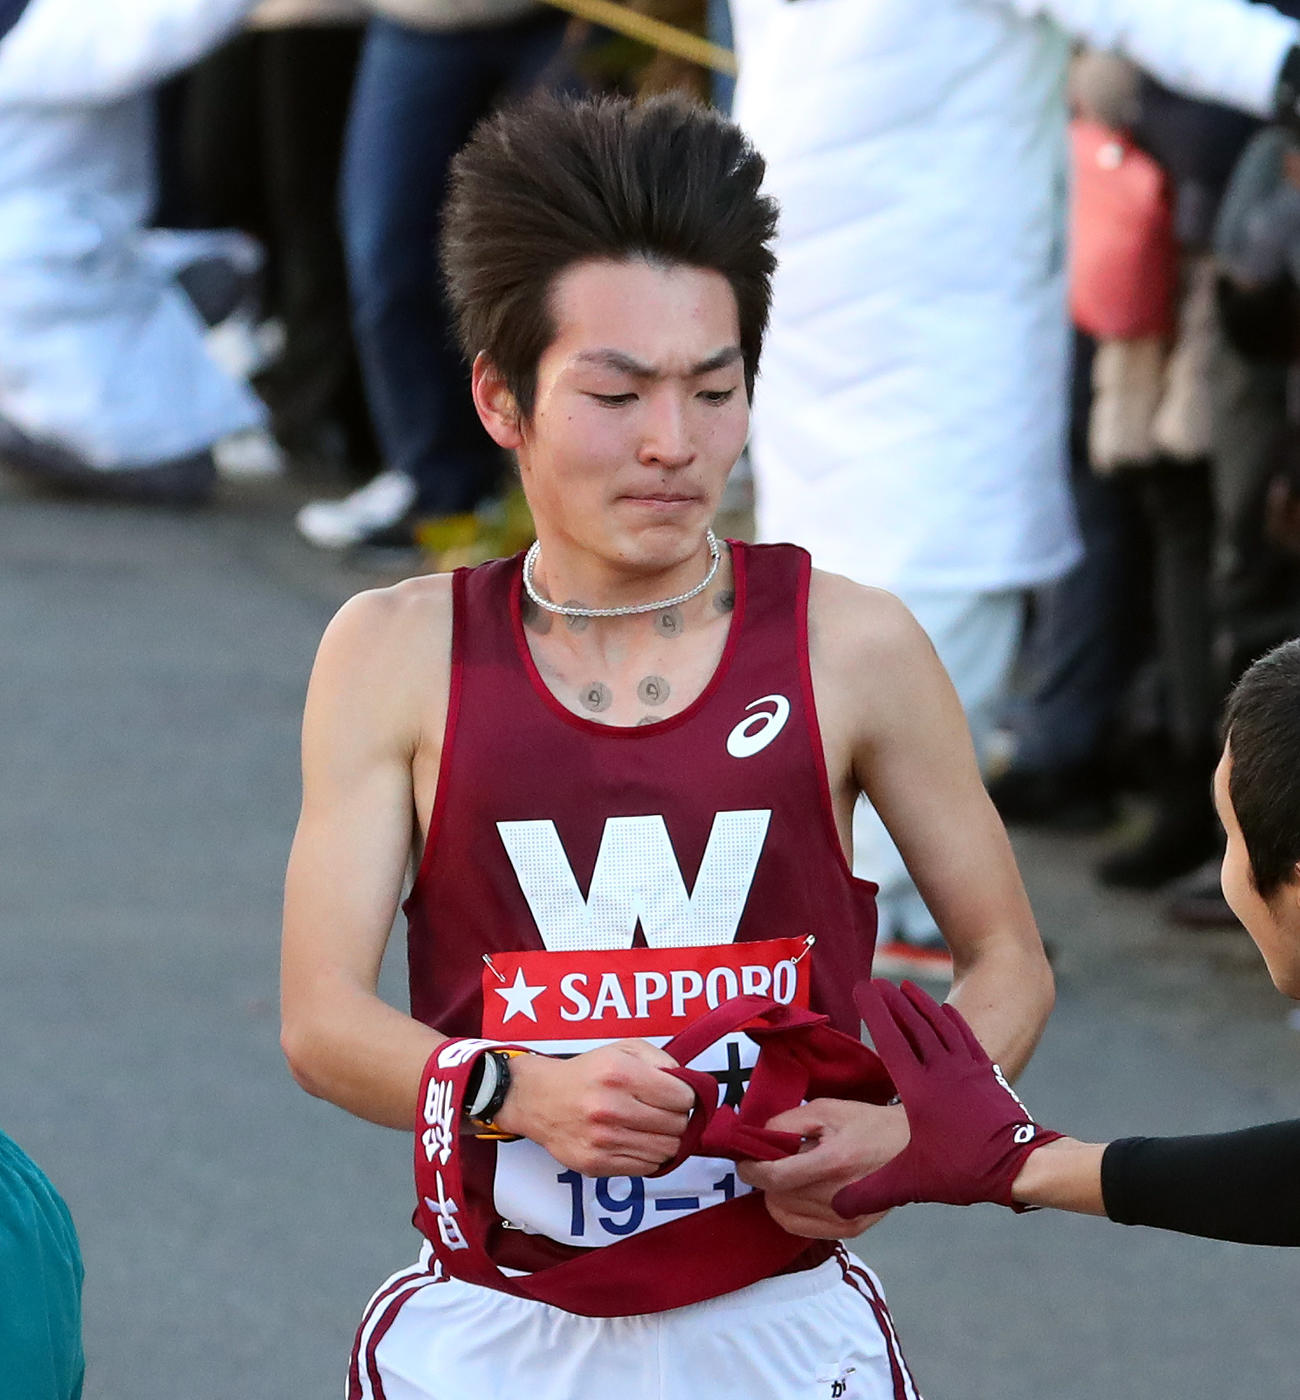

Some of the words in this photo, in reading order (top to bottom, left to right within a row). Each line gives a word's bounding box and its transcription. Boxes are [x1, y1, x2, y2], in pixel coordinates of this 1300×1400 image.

[496, 809, 773, 952] W
[560, 959, 797, 1021] SAPPORO
[557, 1168, 755, 1236] 19-1
